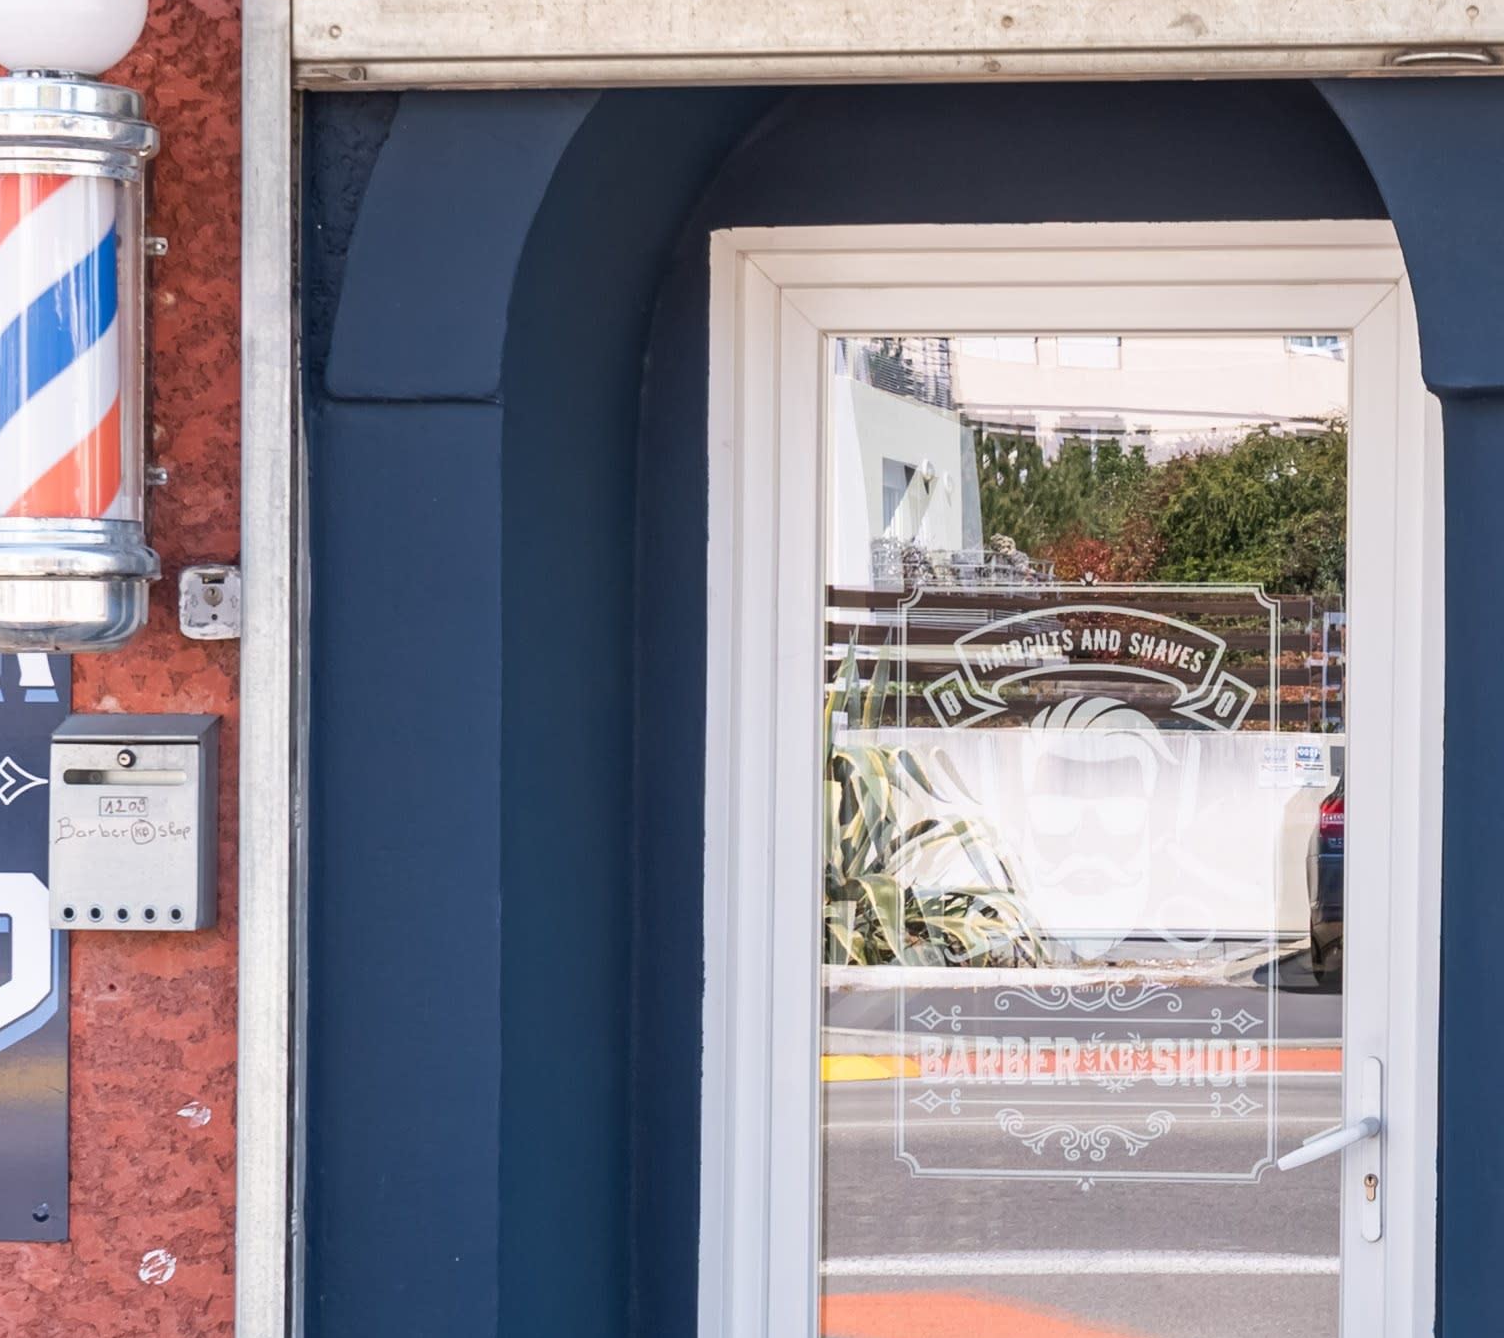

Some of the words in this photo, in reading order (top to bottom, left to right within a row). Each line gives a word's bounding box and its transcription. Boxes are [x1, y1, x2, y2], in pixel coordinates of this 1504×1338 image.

[975, 629, 1074, 674] HAIRCUTS
[1080, 628, 1122, 652] AND
[1128, 631, 1207, 674] SHAVES
[54, 816, 130, 845] Barber
[919, 1035, 1082, 1086] BARBER
[1099, 1042, 1134, 1072] KB
[1150, 1037, 1260, 1087] SHOP
